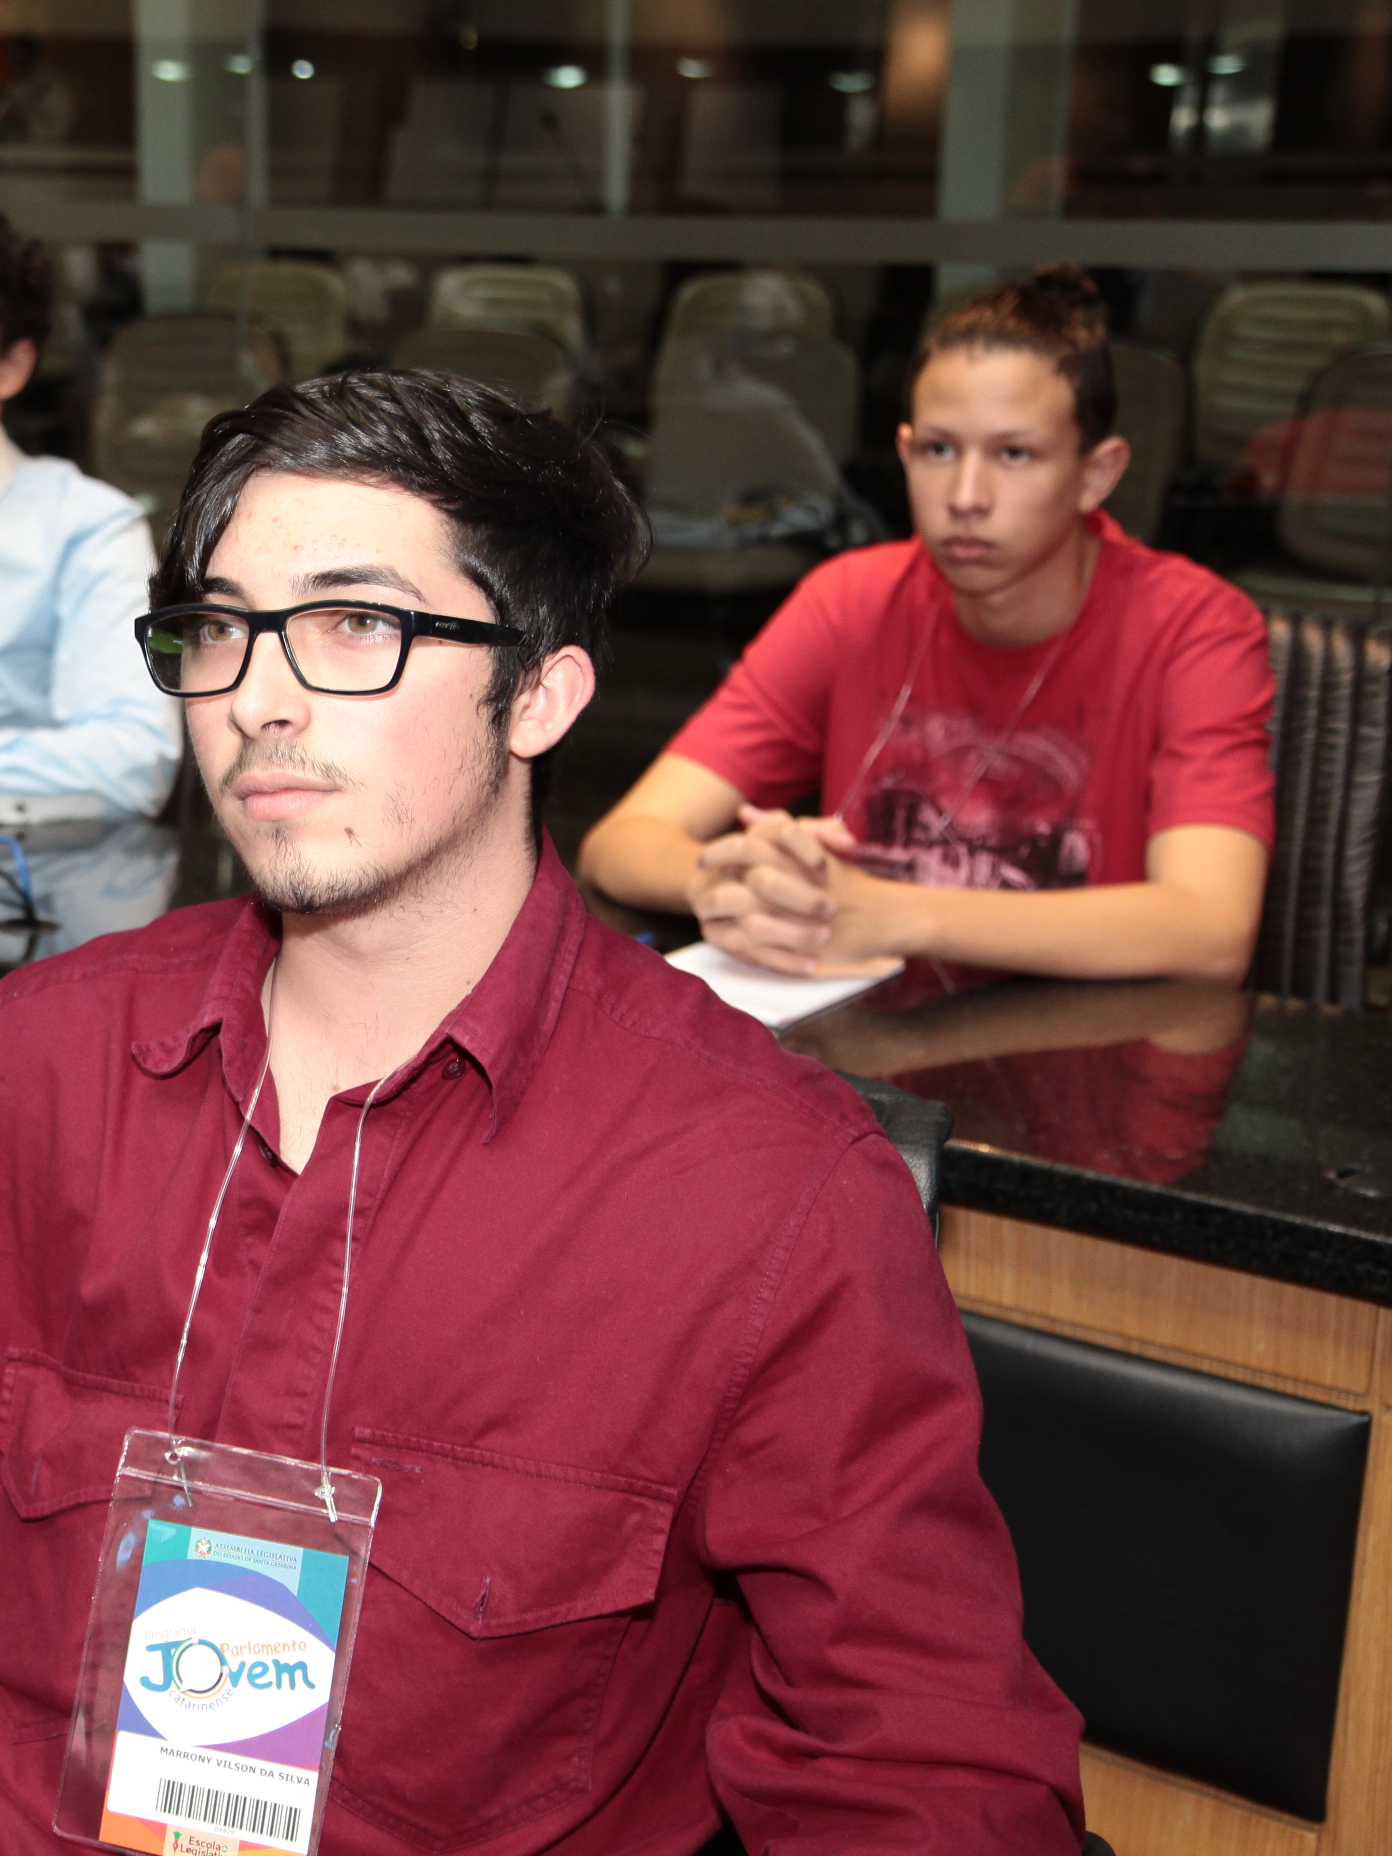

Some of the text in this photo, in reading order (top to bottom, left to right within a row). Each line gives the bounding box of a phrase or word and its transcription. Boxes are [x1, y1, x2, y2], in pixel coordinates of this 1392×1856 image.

[215, 1543, 298, 1563] ASSEMBLEIA LEGISLATIVA
[144, 1626, 196, 1643] Programa
[219, 1639, 307, 1657] Parlamento
[168, 1687, 235, 1712] catarinense
[159, 1746, 312, 1787] MARRONY VILSON DA SILVA
[188, 1836, 221, 1851] Escola
